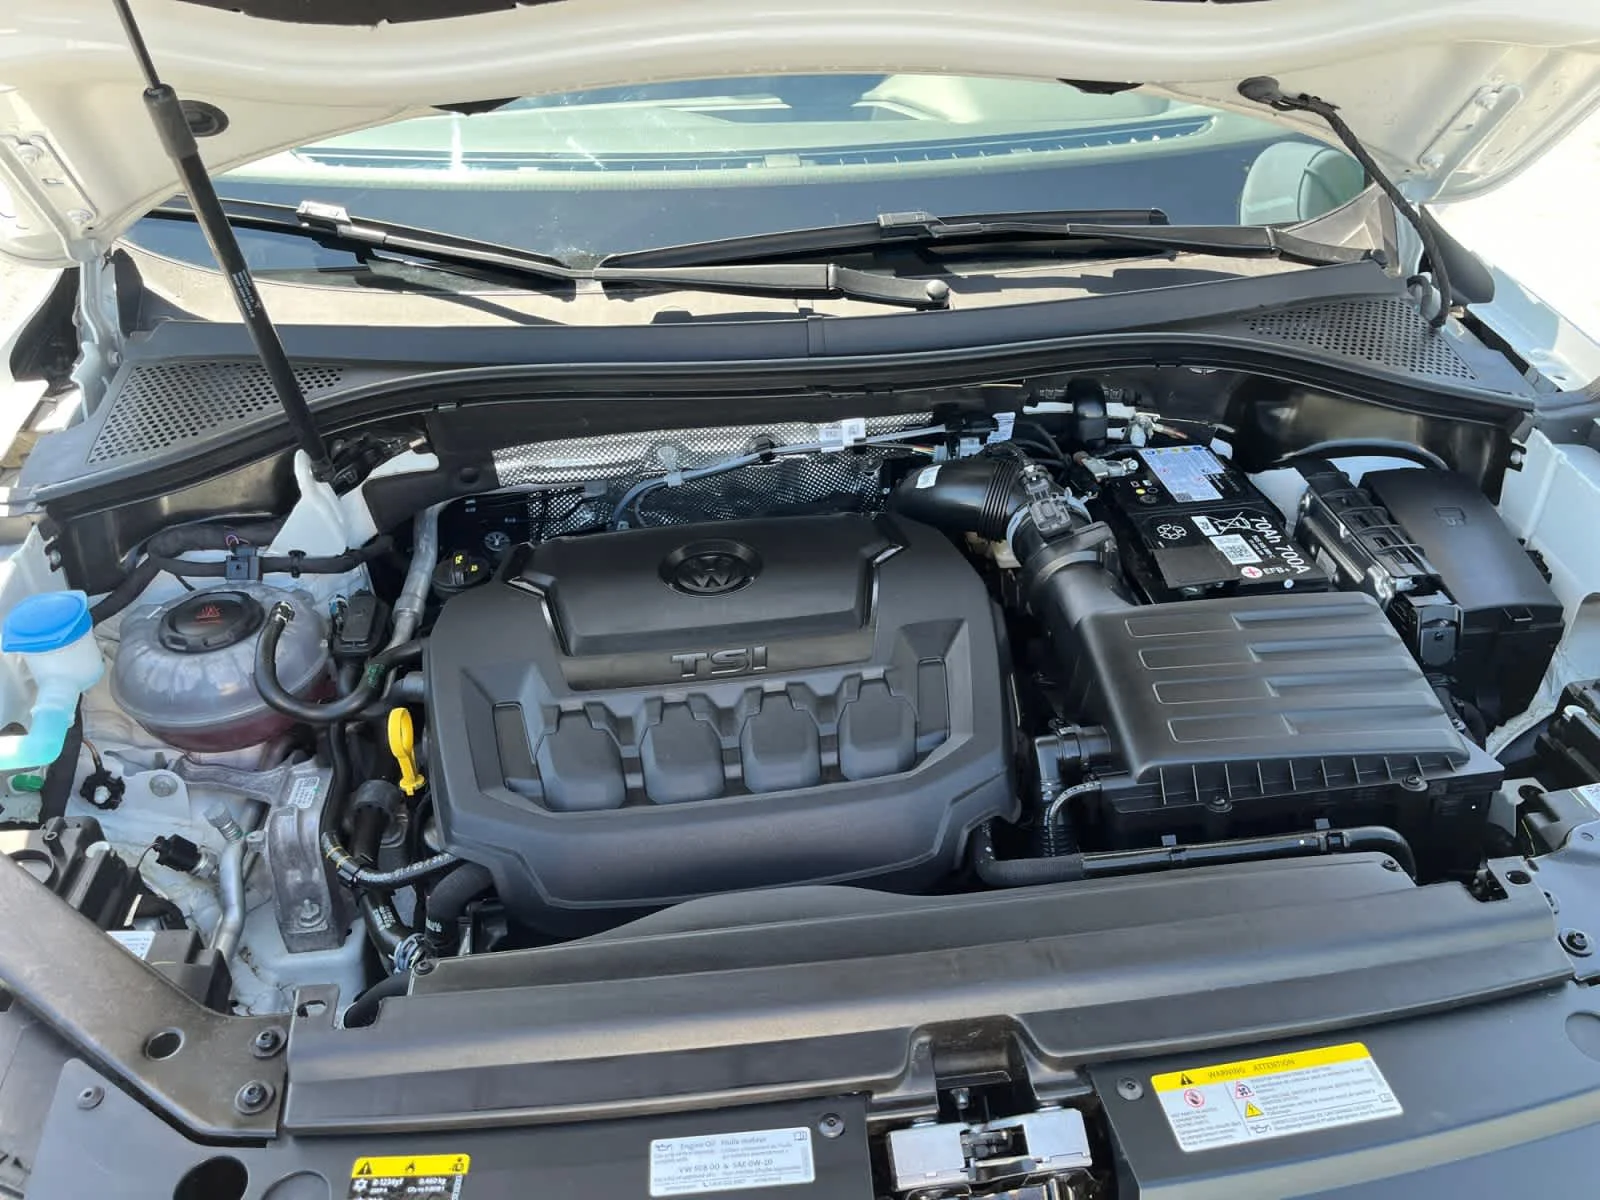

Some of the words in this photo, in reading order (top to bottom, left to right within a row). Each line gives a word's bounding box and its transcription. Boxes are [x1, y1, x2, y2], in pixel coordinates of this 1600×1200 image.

[1249, 516, 1283, 544] 70Ah
[1274, 544, 1312, 575] 700A
[670, 645, 769, 678] TSI
[1207, 1066, 1246, 1079] WARNING
[1253, 1058, 1296, 1072] ATTENTION
